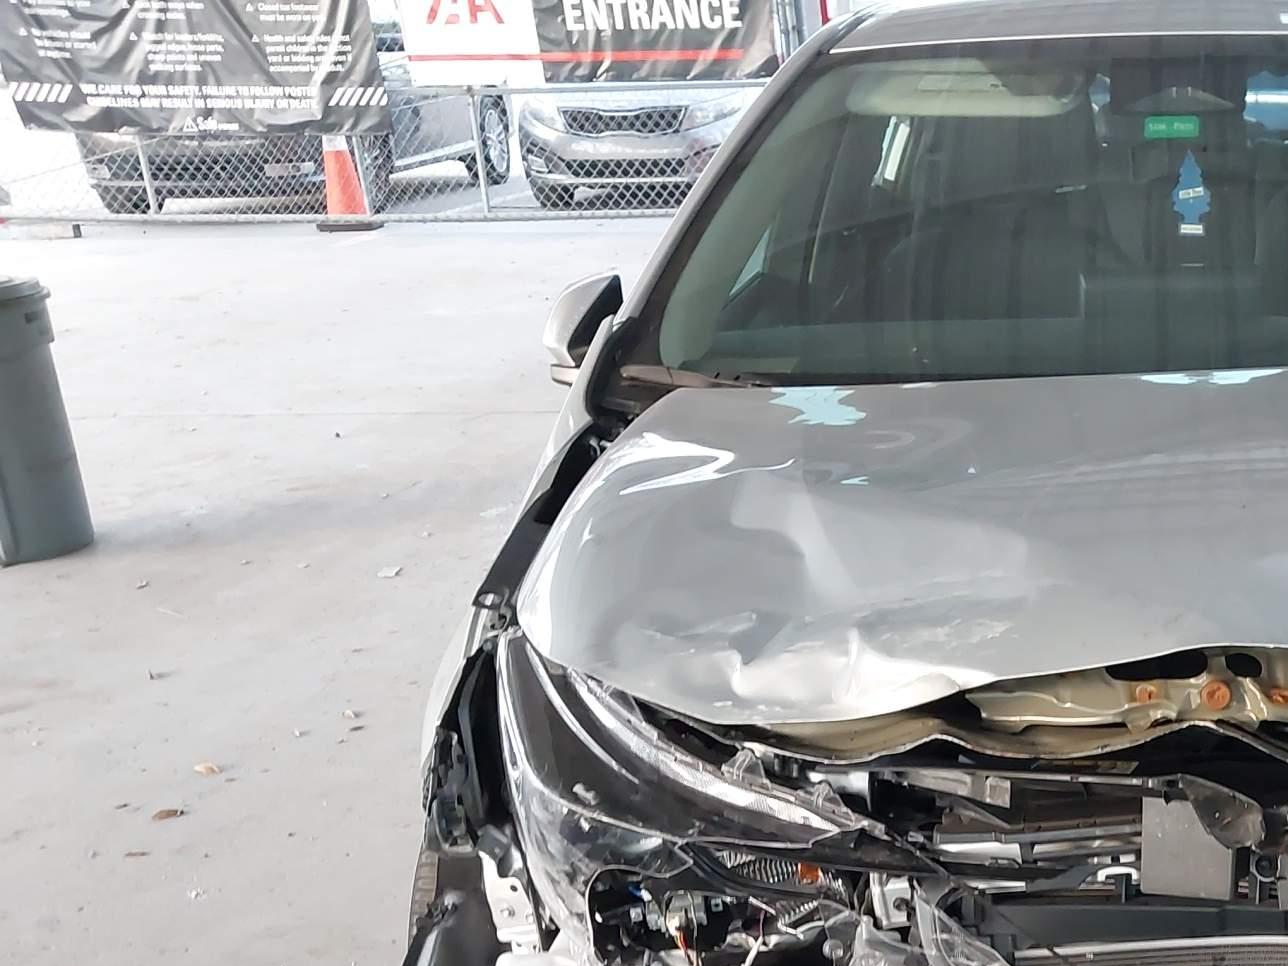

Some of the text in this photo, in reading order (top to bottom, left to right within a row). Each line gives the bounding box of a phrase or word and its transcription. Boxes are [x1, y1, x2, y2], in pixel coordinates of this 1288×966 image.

[563, 0, 742, 30] ENTRANCE
[98, 84, 122, 94] CARE
[143, 85, 167, 94] YOUR
[250, 86, 284, 96] FOLLOW
